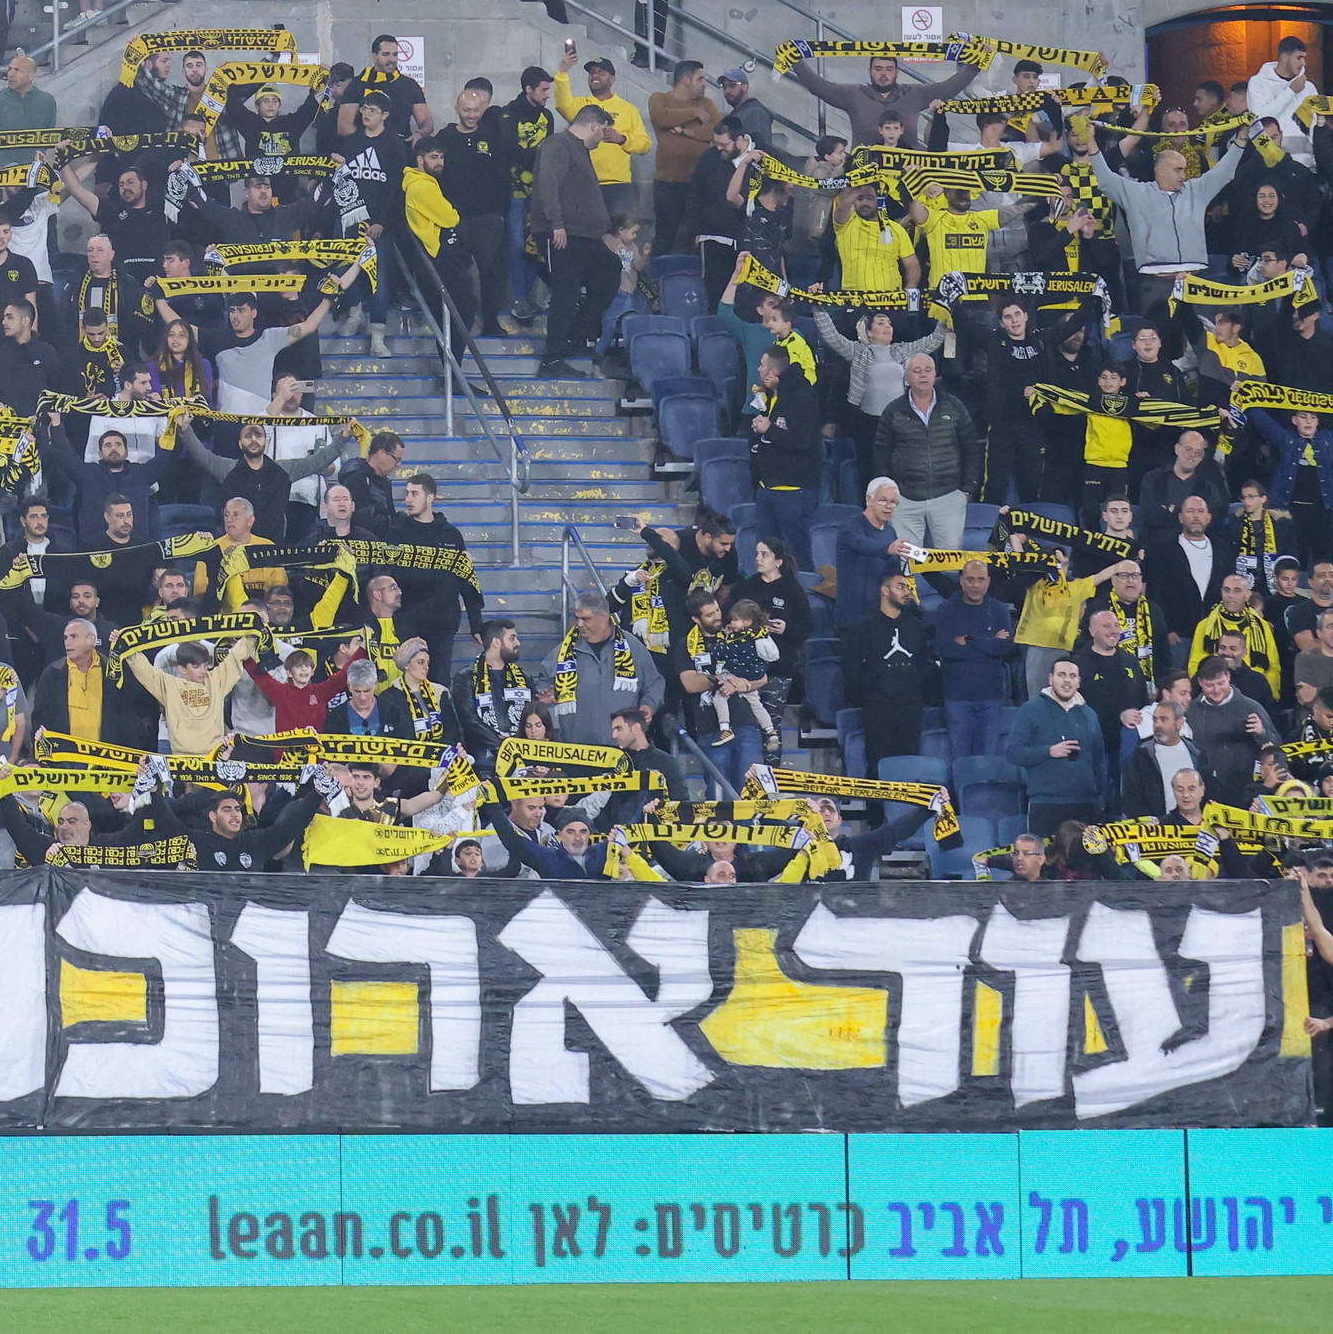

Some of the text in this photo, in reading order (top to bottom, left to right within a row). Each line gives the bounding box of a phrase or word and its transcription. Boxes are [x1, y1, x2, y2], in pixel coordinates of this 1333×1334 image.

[222, 66, 310, 84] ירושלים
[1001, 42, 1089, 64] ירושלים
[949, 153, 995, 168] בית"ר
[1047, 280, 1096, 291] JERUSALEM
[1011, 511, 1131, 557] בית"ר ירושלים
[126, 612, 254, 645] בית"ר ירושלים
[534, 745, 607, 762] JERUSALEM
[14, 773, 84, 787] ירושלים
[653, 824, 766, 841] ירושלים
[793, 896, 1265, 1119] עוד
[27, 1199, 131, 1261] 31.5
[209, 1193, 505, 1261] leaan.co.il
[529, 1195, 612, 1268] לאן
[635, 1202, 866, 1259] כרטיסים:
[888, 1202, 1005, 1257] אביב
[1029, 1192, 1089, 1255] תל
[1111, 1196, 1296, 1263] יהושע,
